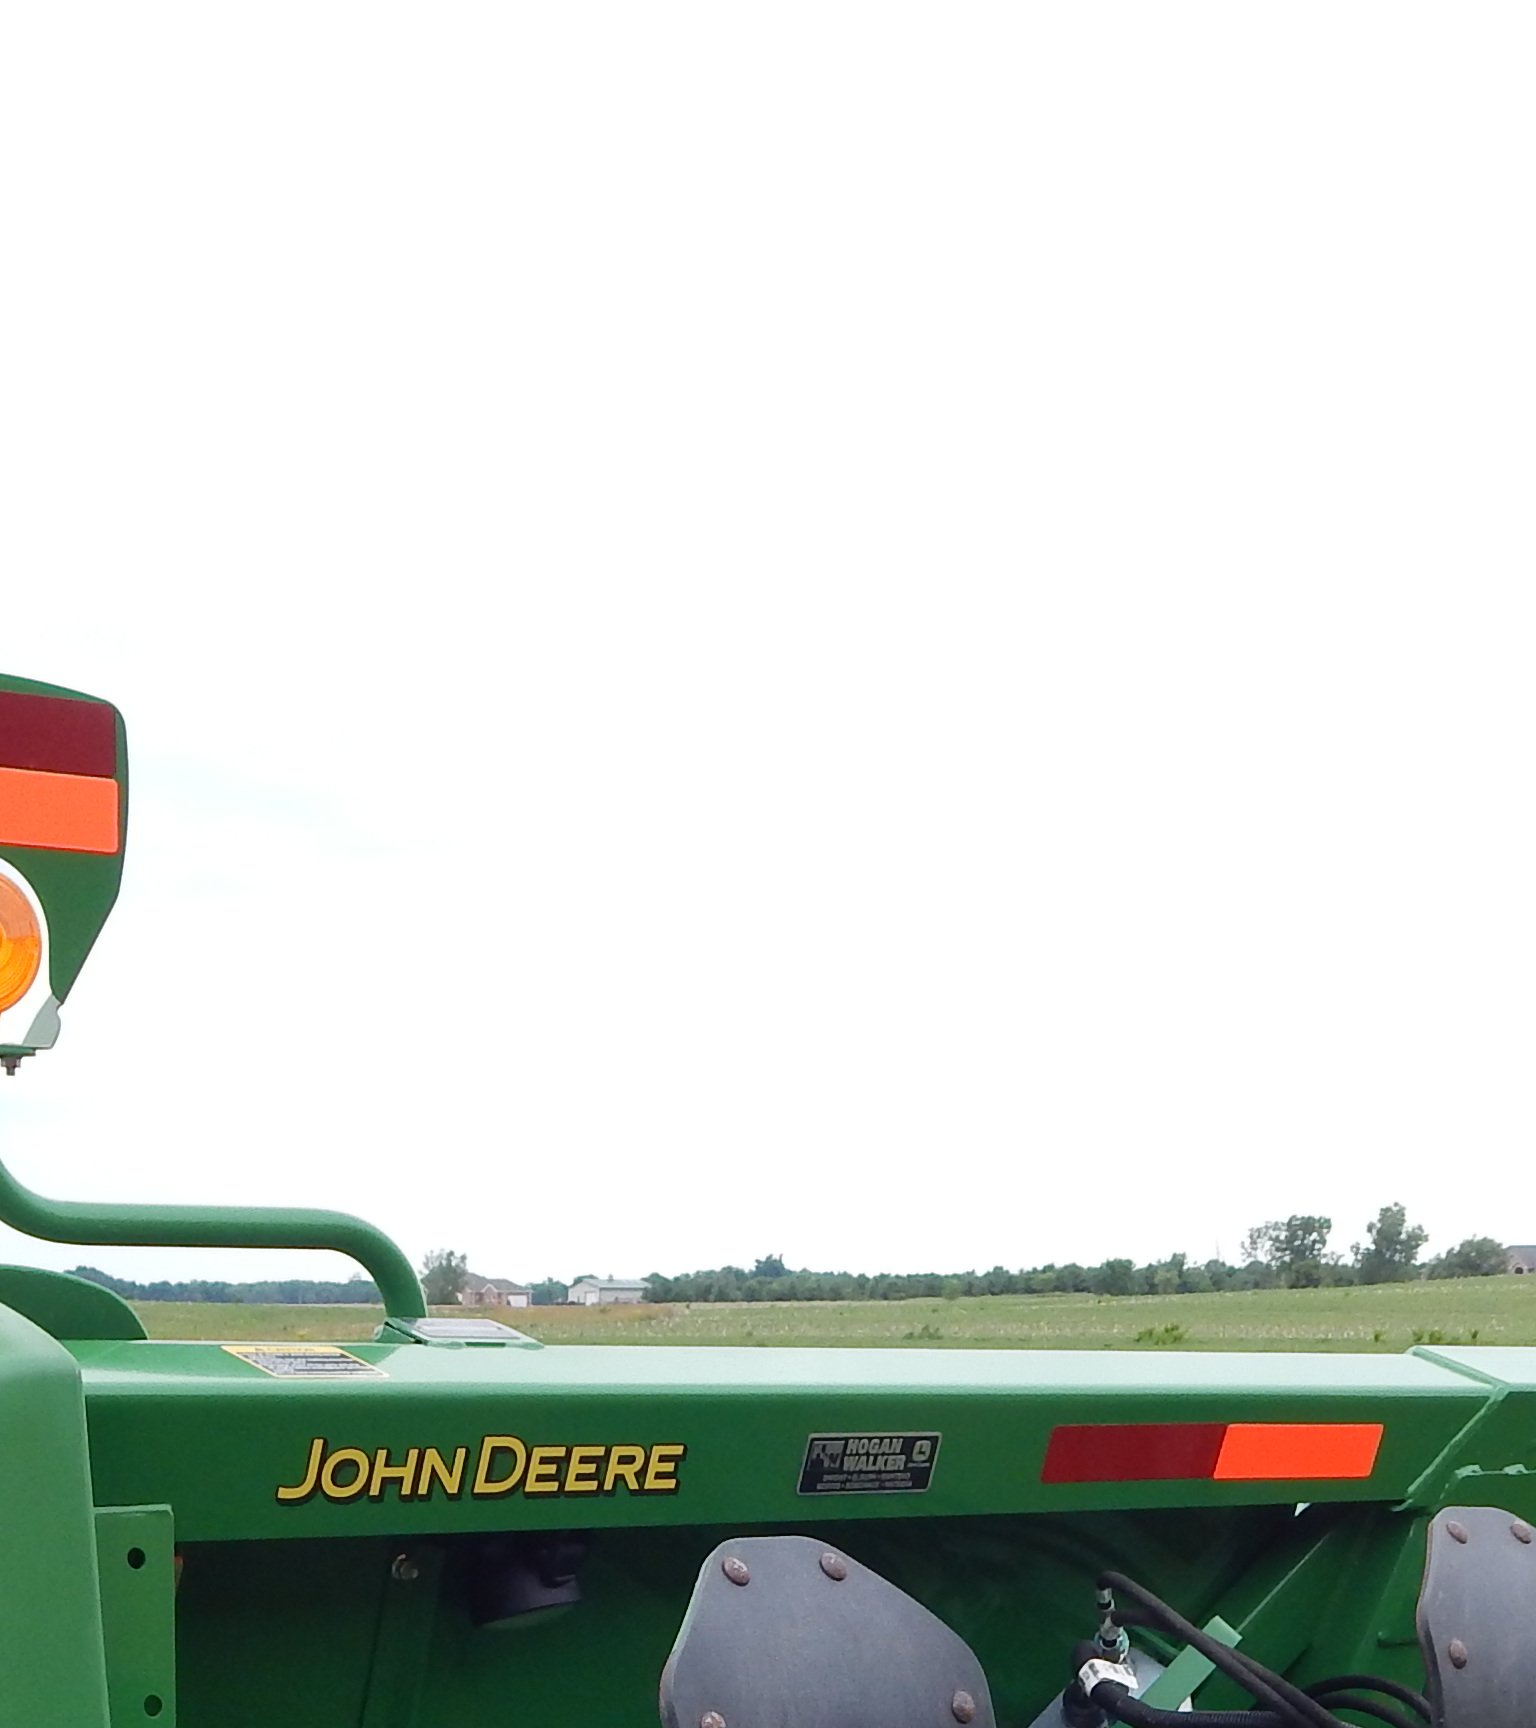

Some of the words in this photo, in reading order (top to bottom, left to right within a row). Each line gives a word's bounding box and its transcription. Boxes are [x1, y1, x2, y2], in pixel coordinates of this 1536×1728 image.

[845, 1438, 904, 1455] HOGAN
[275, 1436, 467, 1502] JOHN
[472, 1434, 685, 1499] DEERE
[842, 1454, 906, 1472] WALKER
